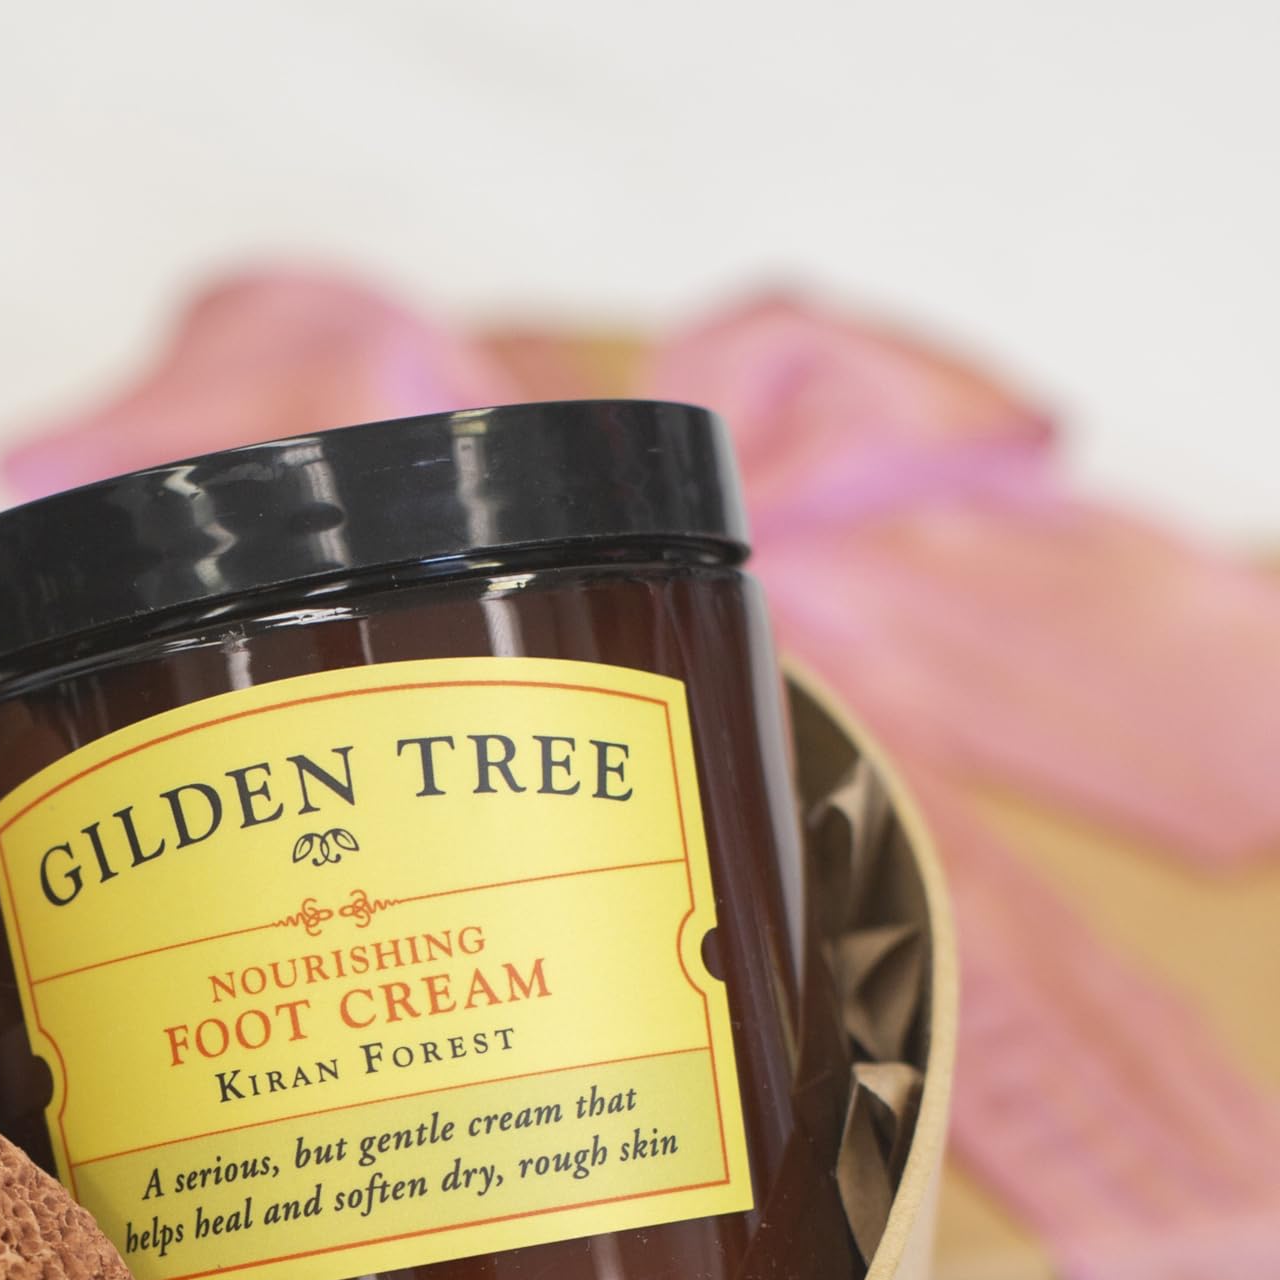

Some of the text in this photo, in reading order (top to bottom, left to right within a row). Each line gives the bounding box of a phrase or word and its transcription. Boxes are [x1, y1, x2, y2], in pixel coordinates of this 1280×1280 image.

[38, 732, 635, 908] GILDEN TREE
[163, 957, 554, 1067] FOOT CREAM
[209, 926, 487, 1004] NOURISHING
[125, 1128, 679, 1256] helps heal and soften dry, rough skin
[142, 1085, 638, 1201] A serious, but gentle cream that
